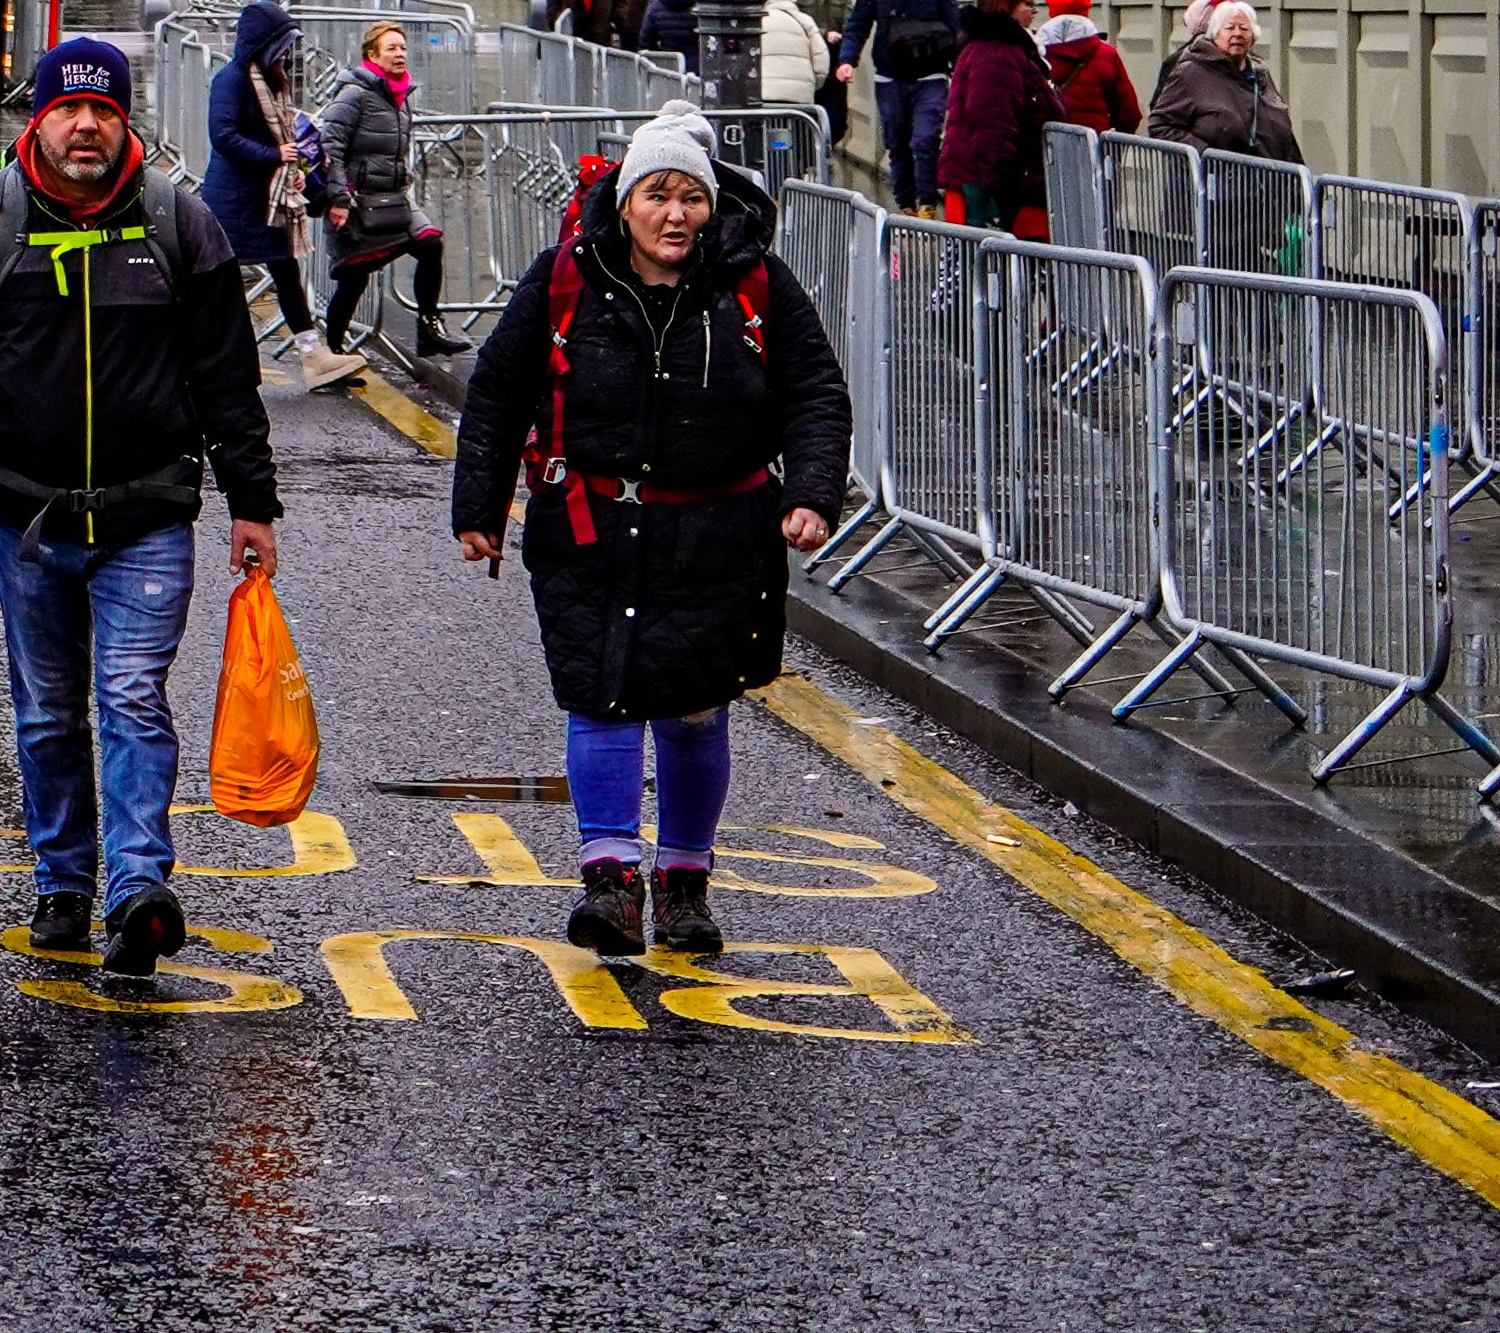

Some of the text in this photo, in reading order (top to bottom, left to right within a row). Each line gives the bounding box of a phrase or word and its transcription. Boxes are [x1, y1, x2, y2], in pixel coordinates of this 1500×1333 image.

[61, 63, 94, 76] HELP
[63, 74, 111, 89] HEROES
[0, 921, 982, 1046] BUS
